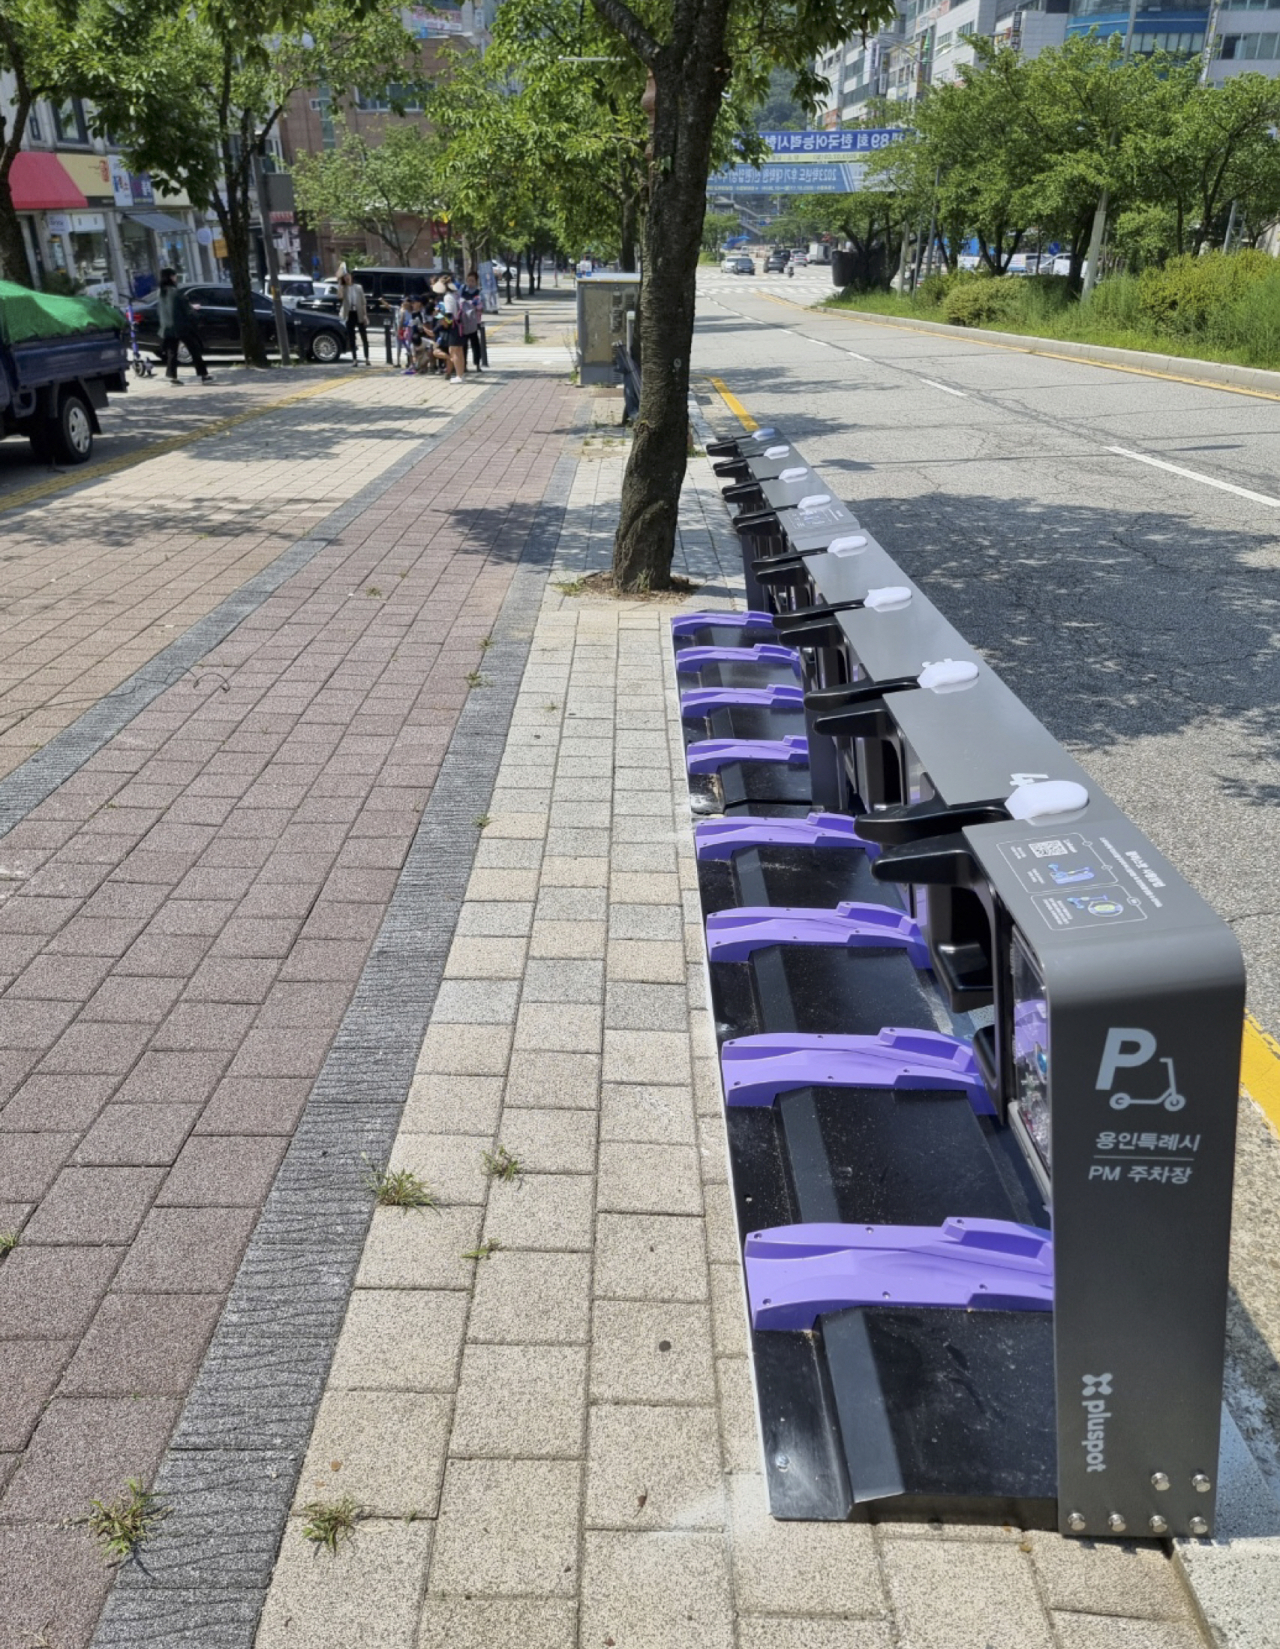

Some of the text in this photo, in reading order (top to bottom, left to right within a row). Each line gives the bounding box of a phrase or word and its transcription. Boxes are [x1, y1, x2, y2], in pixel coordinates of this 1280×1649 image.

[1095, 1027, 1157, 1091] P
[1095, 1131, 1201, 1152] 용인특례시
[1088, 1165, 1192, 1184] PM 주차장
[1081, 1399, 1112, 1472] pluspot
